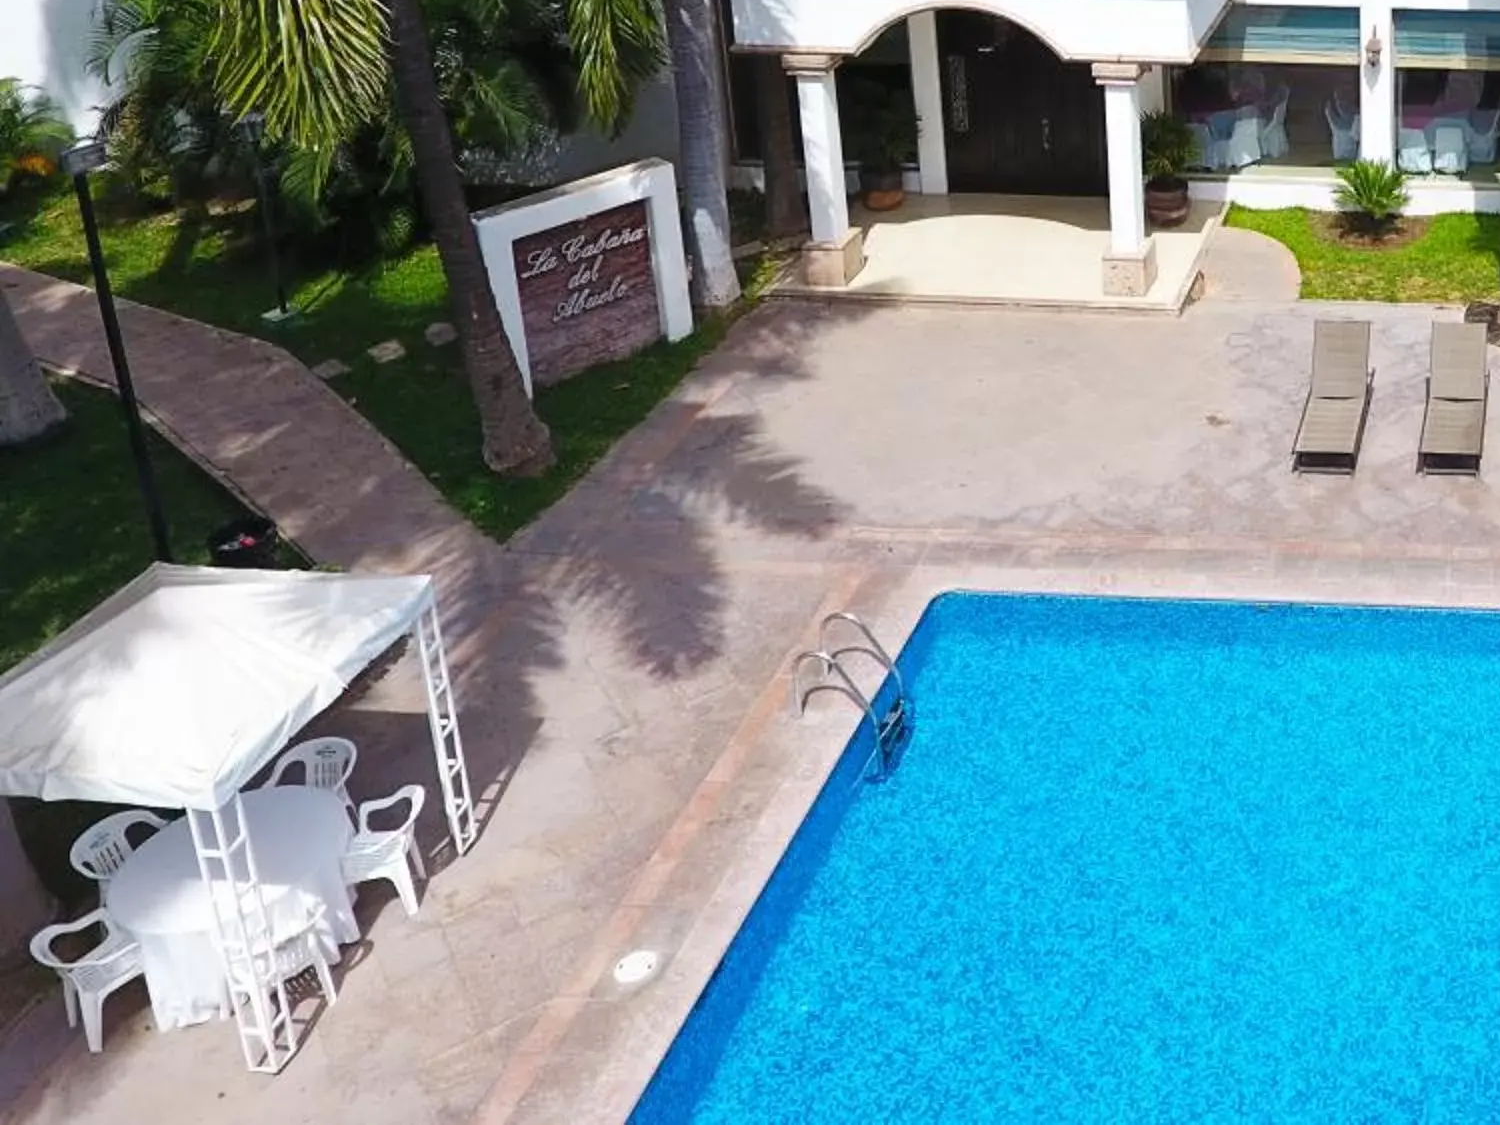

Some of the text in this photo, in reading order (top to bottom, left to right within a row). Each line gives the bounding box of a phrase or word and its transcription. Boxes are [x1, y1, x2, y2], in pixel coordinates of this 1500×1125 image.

[521, 247, 558, 279] La
[567, 255, 604, 289] del
[553, 276, 628, 322] Abuelo
